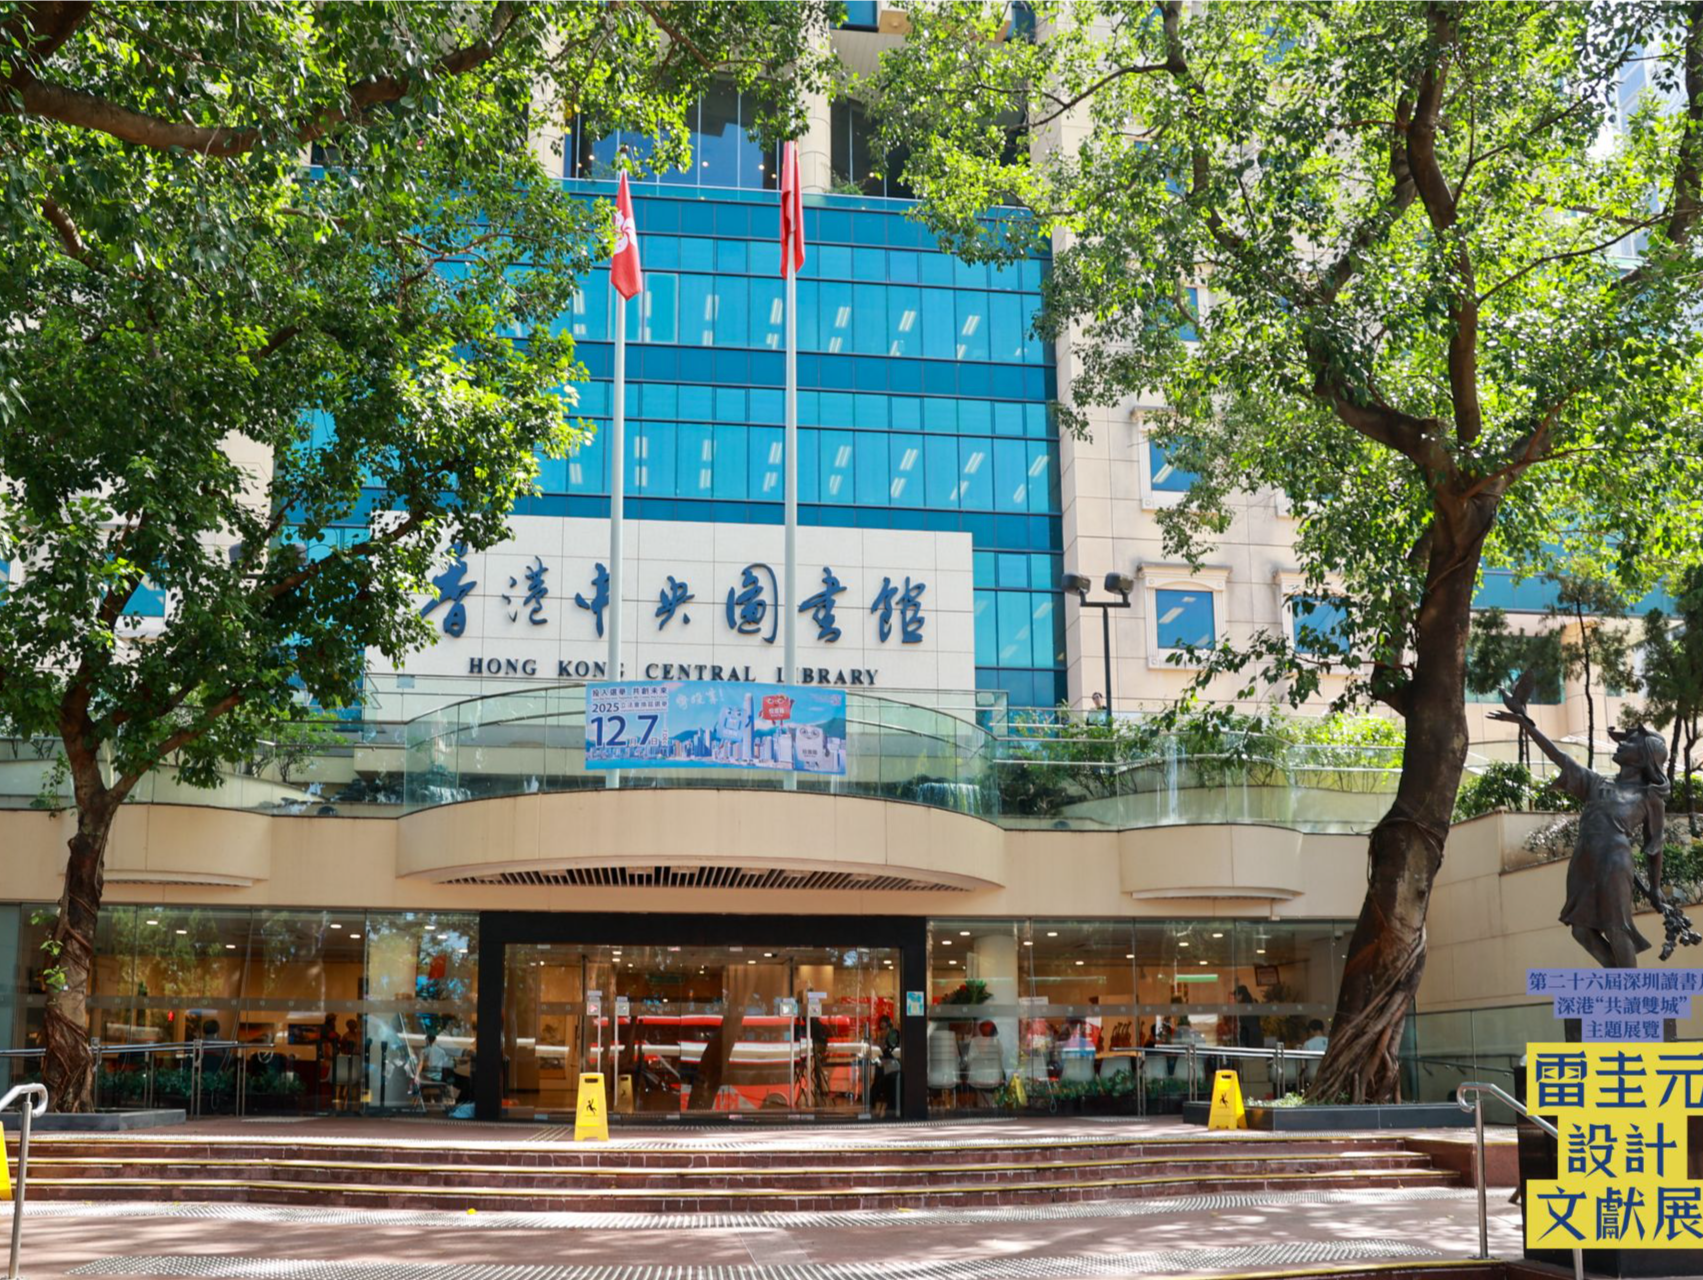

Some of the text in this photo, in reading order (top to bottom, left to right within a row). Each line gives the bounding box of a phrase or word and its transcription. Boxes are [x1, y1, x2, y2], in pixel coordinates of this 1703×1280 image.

[468, 657, 537, 676] HONG
[645, 663, 757, 683] CENTRAL
[776, 666, 879, 686] LBRARY
[592, 703, 620, 713] 2025
